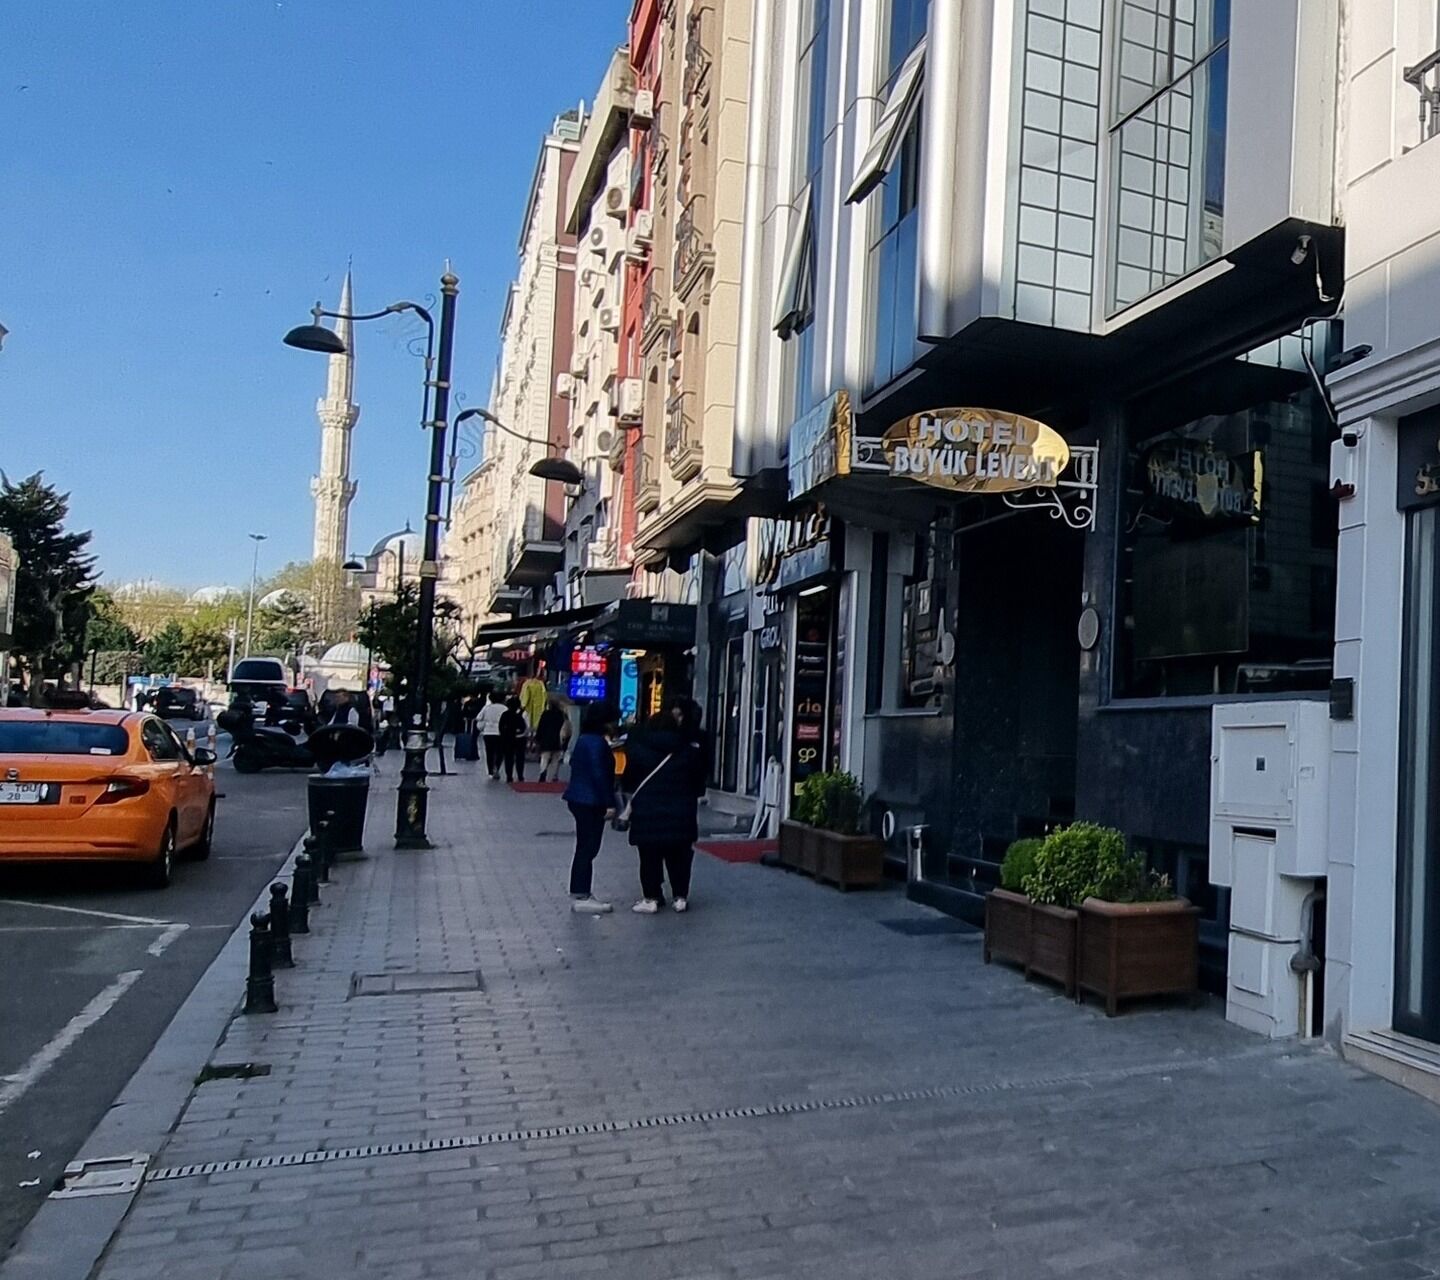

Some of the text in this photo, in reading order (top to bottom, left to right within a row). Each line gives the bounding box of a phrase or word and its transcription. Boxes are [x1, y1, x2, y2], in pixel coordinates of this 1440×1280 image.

[919, 417, 1030, 446] HOTEL
[894, 443, 1057, 482] BÜYÜK LEVENT
